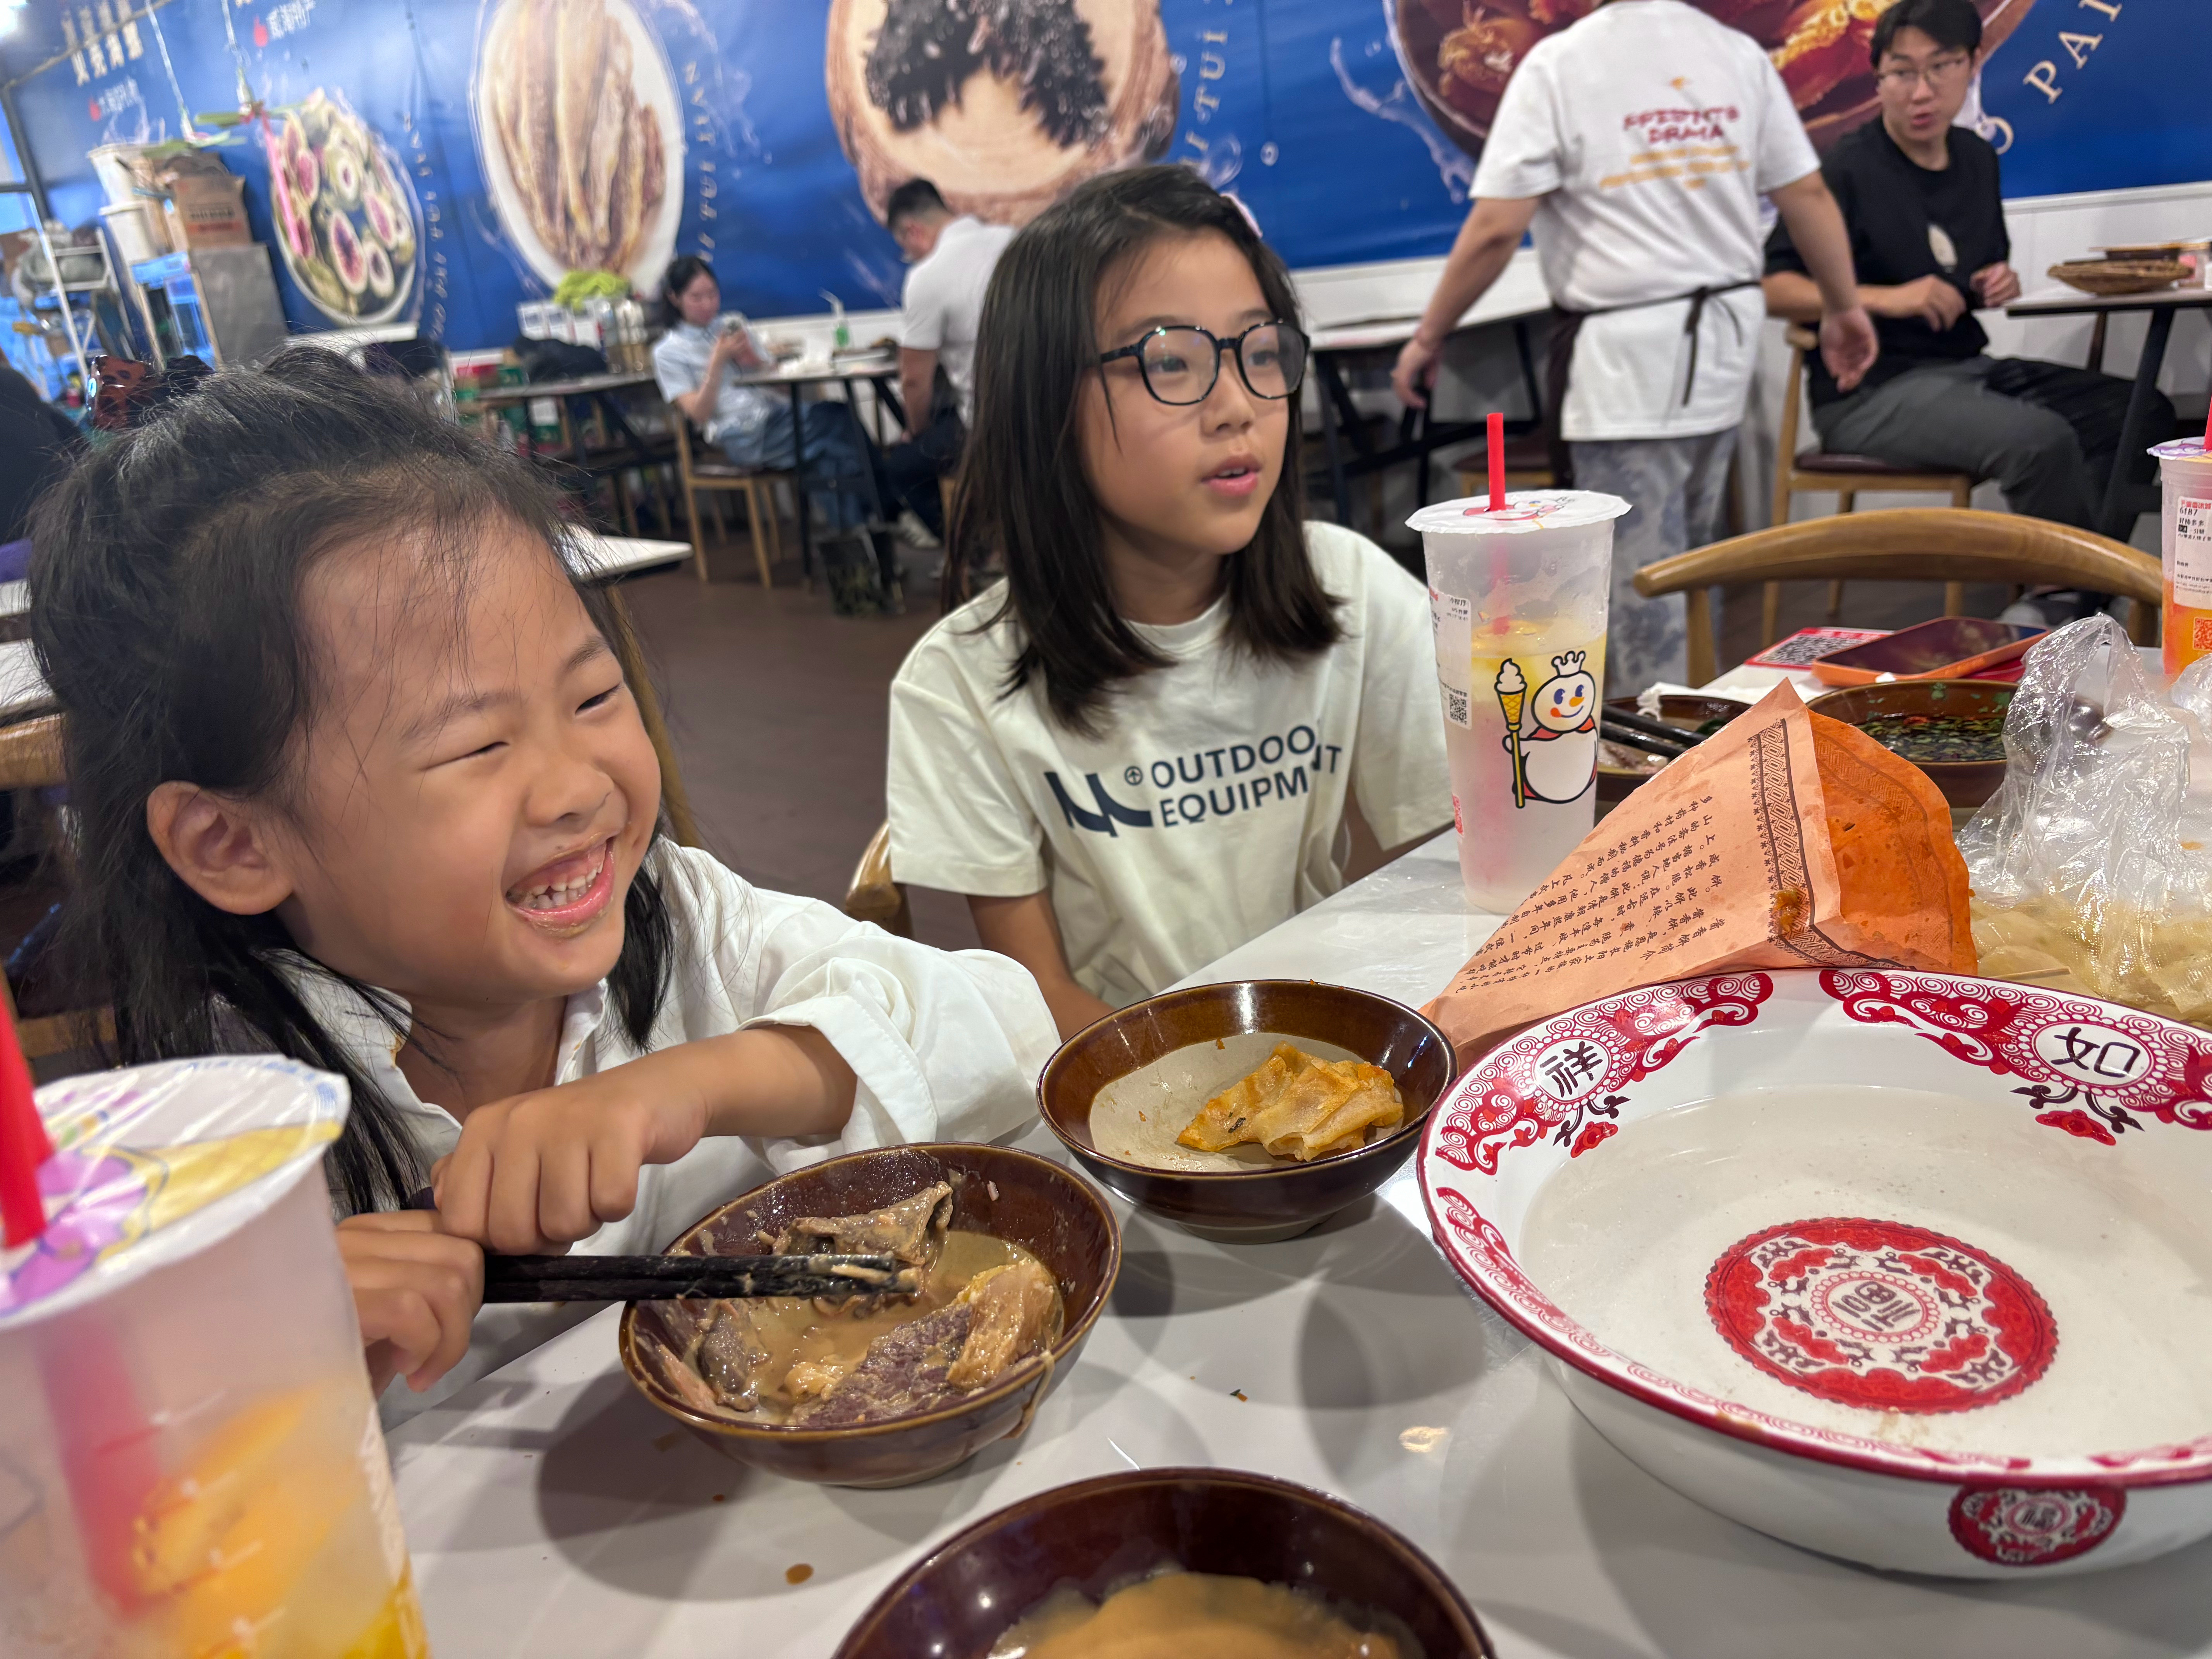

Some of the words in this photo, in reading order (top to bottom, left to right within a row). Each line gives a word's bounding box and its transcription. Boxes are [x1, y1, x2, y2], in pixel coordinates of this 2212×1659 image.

[1193, 29, 1228, 112] TUI
[2023, 0, 2122, 104] PAI
[1640, 919, 1724, 960] 酱香饼简介
[1540, 1040, 1603, 1098] 祥
[2050, 1026, 2140, 1078] 如
